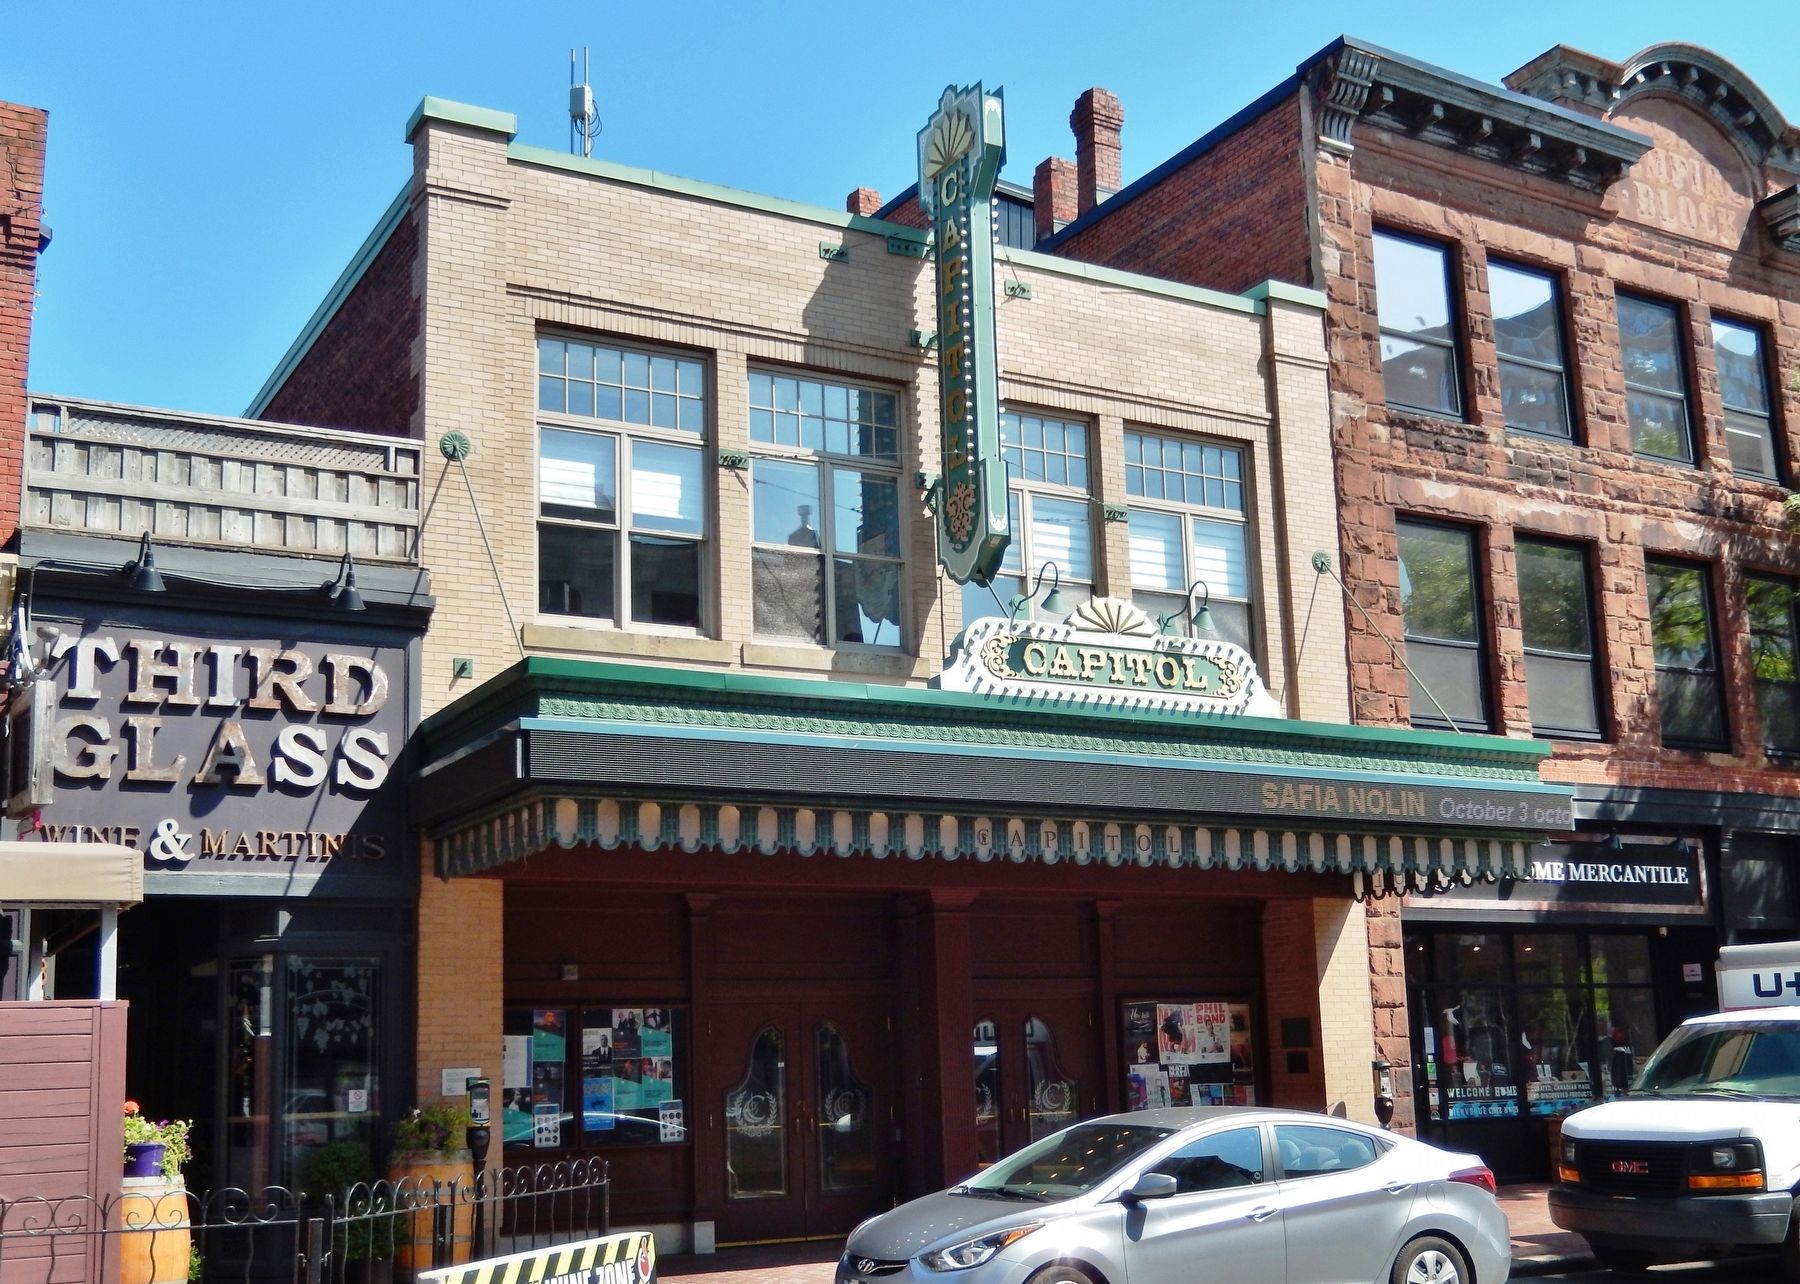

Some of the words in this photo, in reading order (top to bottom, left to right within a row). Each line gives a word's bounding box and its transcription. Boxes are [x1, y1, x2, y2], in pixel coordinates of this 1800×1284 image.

[1634, 180, 1738, 244] BLOCK
[940, 171, 967, 468] CAPITOL
[51, 634, 389, 715] THIRD
[1023, 642, 1208, 691] CAPITOL
[54, 714, 389, 790] GLASS
[1261, 782, 1340, 813] SAFIA
[1348, 788, 1425, 817] NOLIN
[1439, 797, 1514, 822] October
[1519, 802, 1529, 822] 3
[1534, 806, 1572, 825] octo
[41, 823, 140, 847] WINE
[150, 818, 195, 861] &
[201, 827, 386, 861] MARTINIS
[977, 828, 1180, 854] CAPITOL
[1568, 863, 1689, 885] MERCANTILE
[1195, 1003, 1225, 1013] PHIL
[1196, 1014, 1226, 1025] BOND
[1447, 1087, 1491, 1098] WELCOME
[1494, 1086, 1518, 1097] HOME
[1610, 1160, 1649, 1174] GMC
